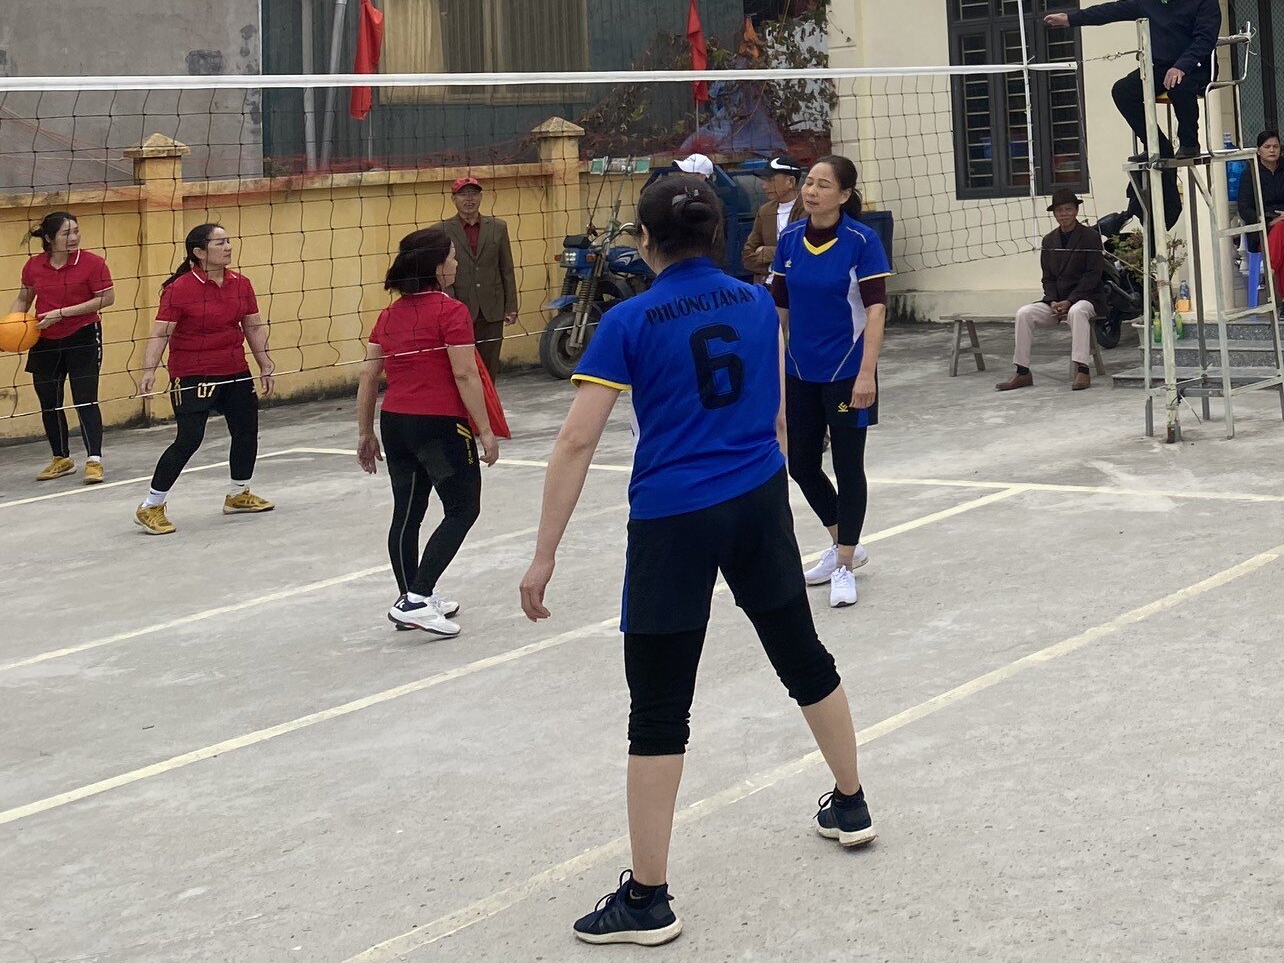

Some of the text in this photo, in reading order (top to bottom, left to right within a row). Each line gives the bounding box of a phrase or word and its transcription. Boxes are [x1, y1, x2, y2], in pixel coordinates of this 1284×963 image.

[645, 295, 710, 327] PHƯỜNG
[710, 286, 735, 311] TÂN
[689, 323, 744, 410] 6
[197, 382, 216, 399] 07
